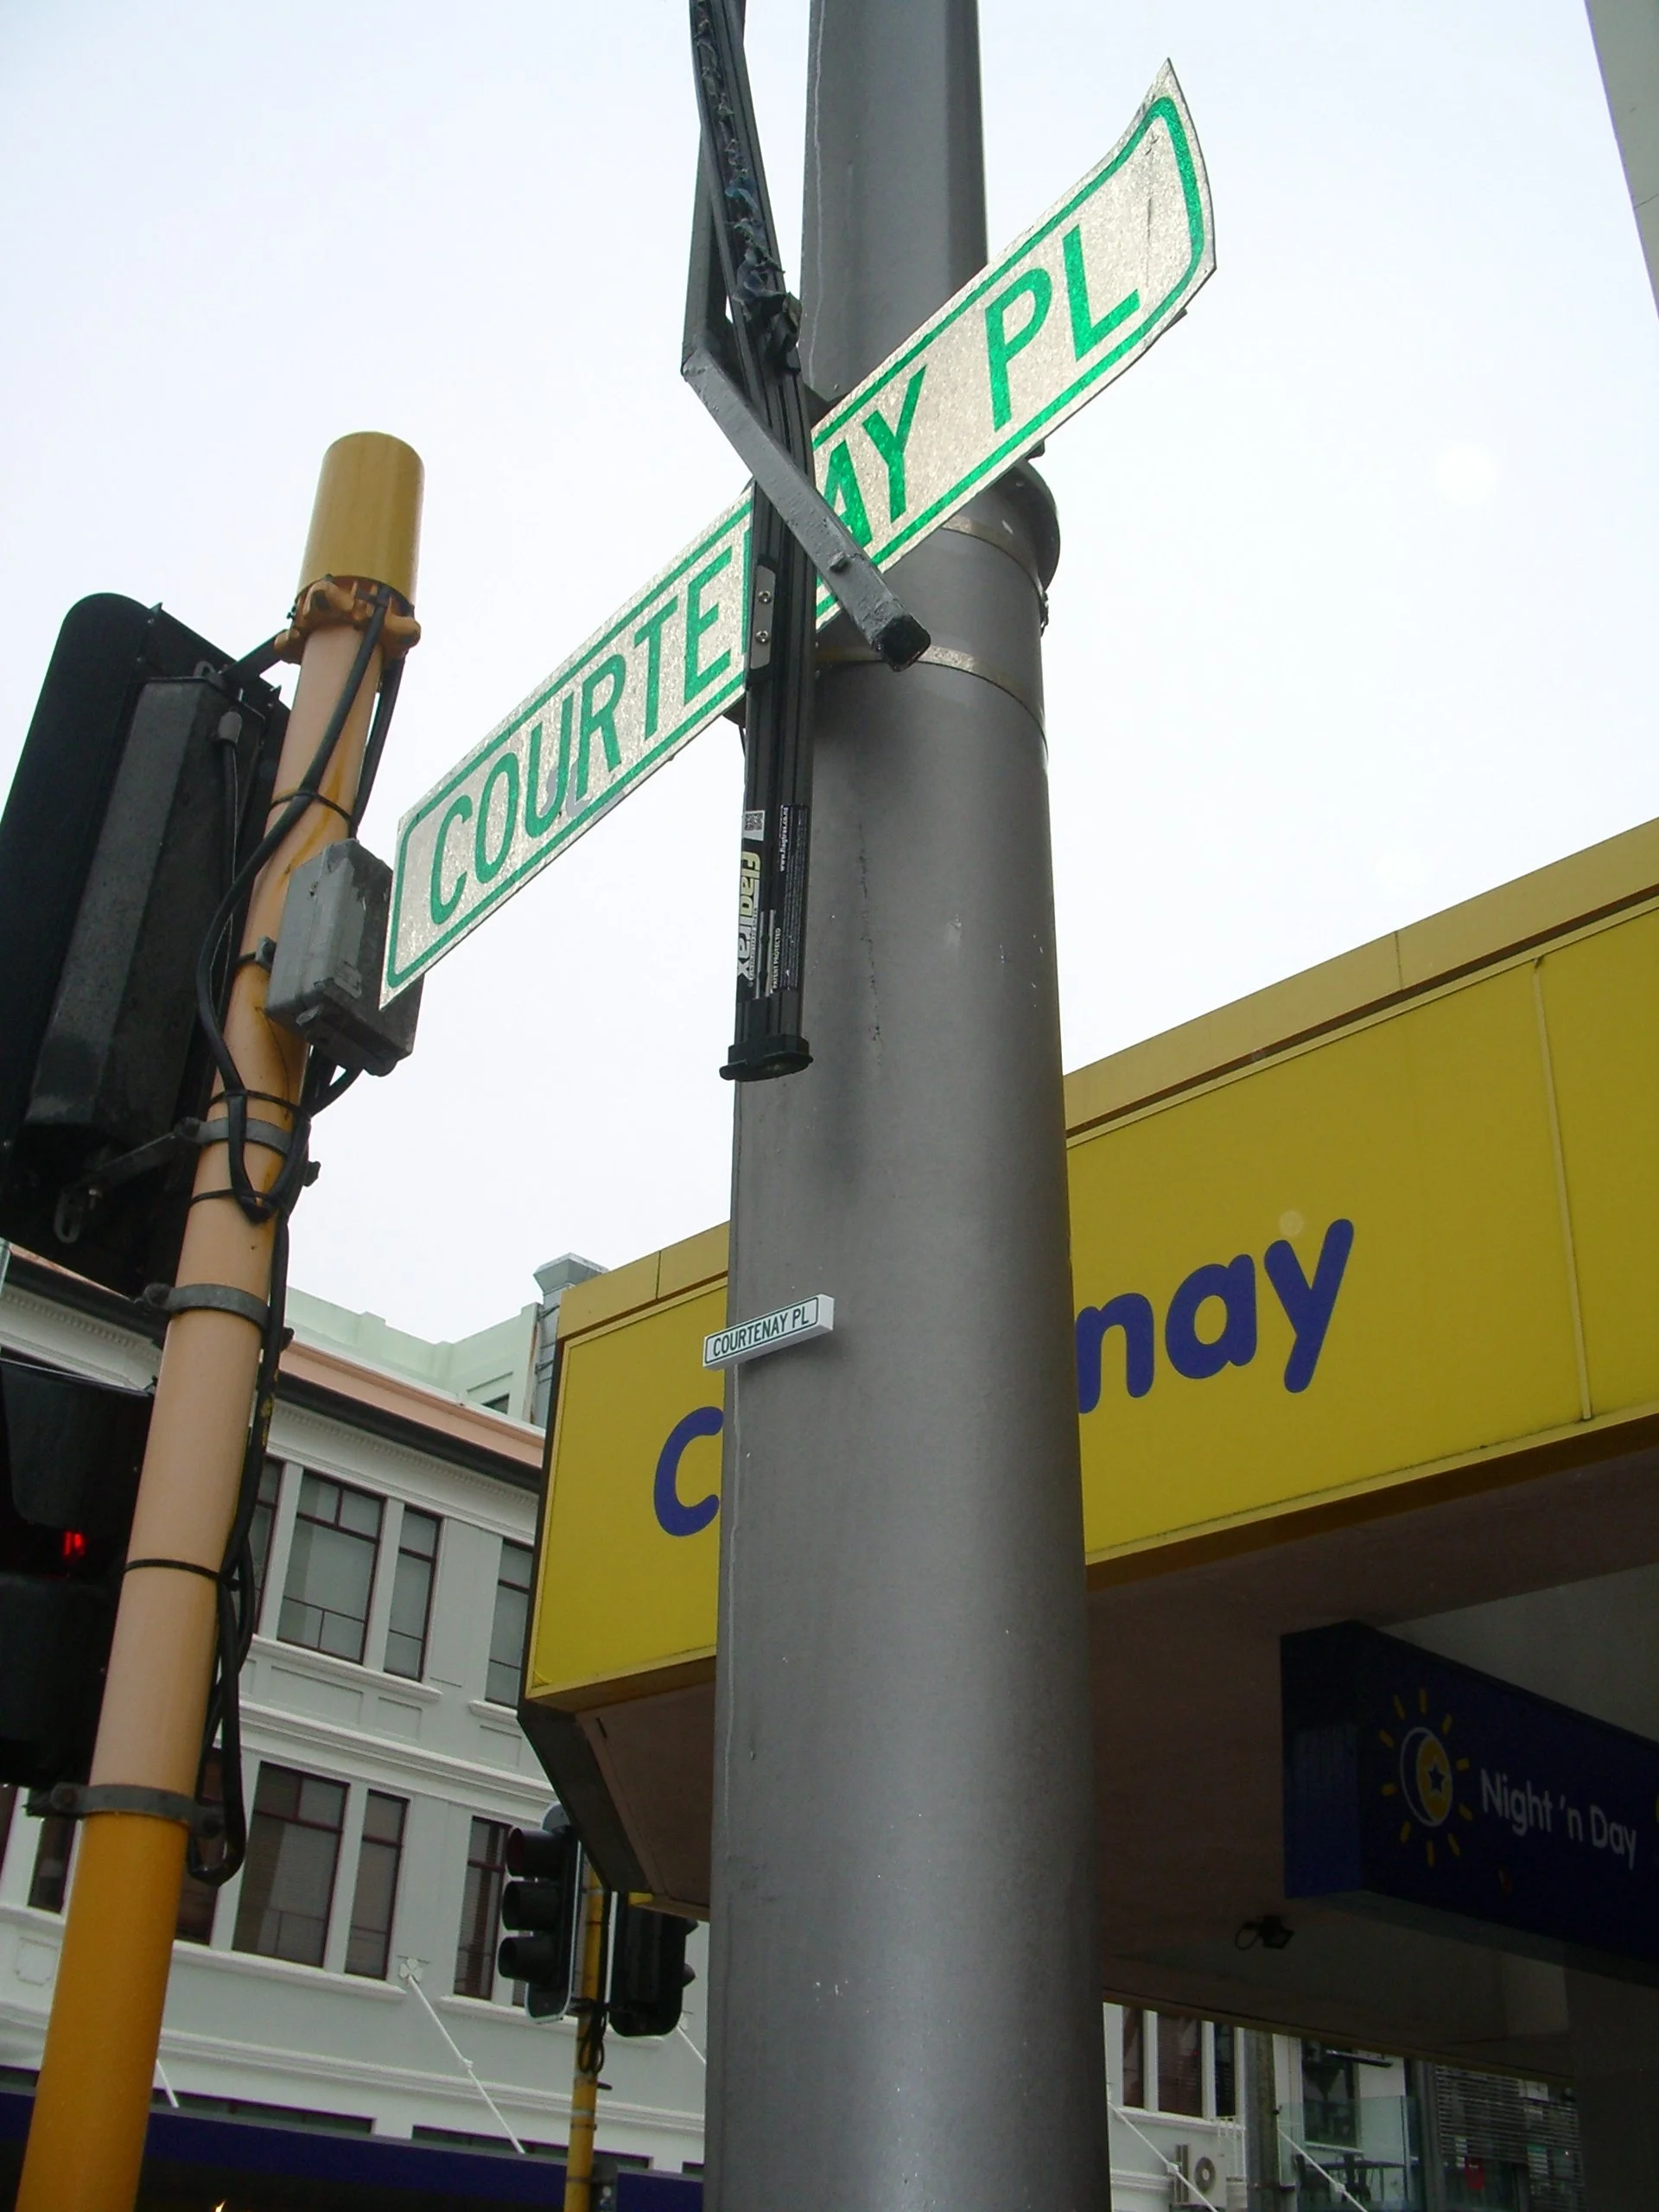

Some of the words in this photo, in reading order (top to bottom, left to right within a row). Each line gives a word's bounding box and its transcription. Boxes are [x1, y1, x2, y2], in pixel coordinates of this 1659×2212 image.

[431, 364, 925, 925] COURTEAY
[984, 224, 1141, 433] PL
[713, 1312, 789, 1357] COURTENAY
[791, 1306, 810, 1329] PL
[1480, 1768, 1554, 1837] Night
[1590, 1804, 1637, 1871] Day
